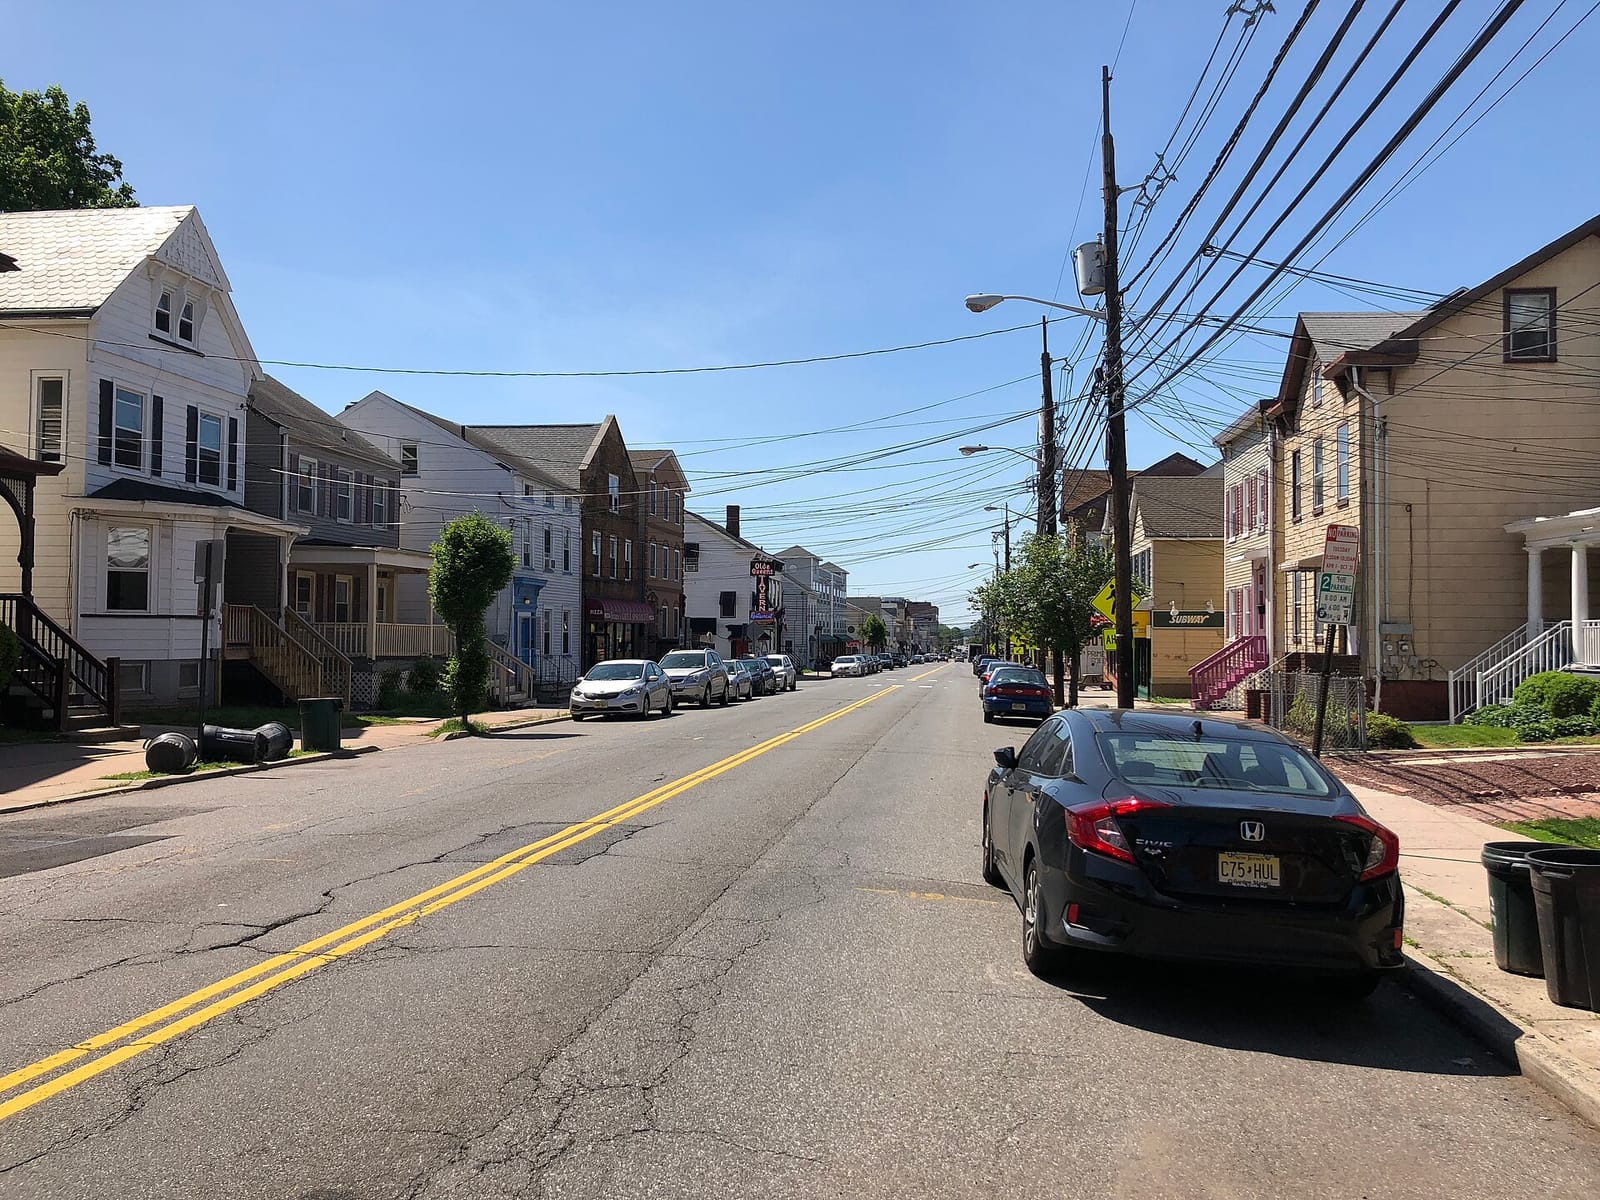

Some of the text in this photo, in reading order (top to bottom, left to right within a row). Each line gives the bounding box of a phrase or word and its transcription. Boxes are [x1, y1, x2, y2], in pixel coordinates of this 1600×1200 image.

[1328, 528, 1358, 538] NO PARKING
[1322, 576, 1330, 589] 2
[1169, 616, 1209, 624] SUBWAY
[1135, 838, 1173, 848] CIVIC
